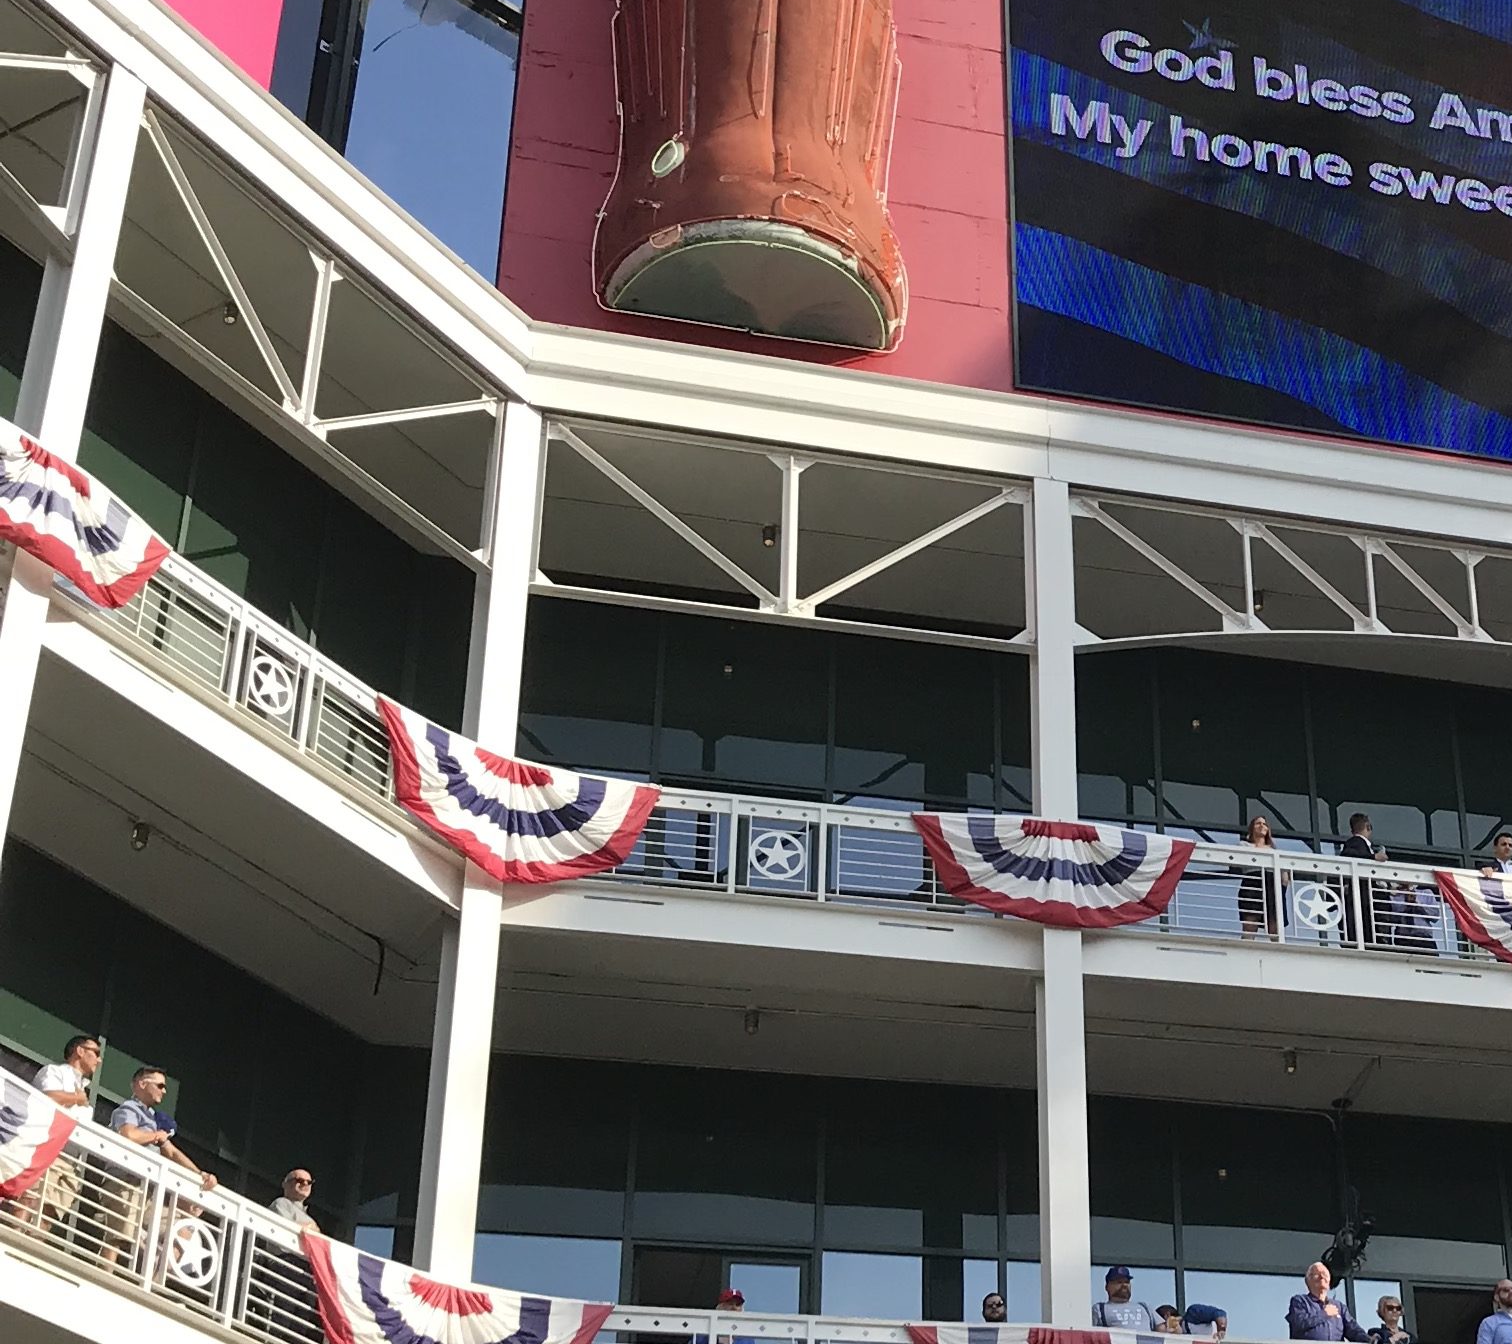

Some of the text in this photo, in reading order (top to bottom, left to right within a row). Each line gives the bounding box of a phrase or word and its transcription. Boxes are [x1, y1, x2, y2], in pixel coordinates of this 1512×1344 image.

[1100, 29, 1237, 92] God
[1252, 55, 1416, 124] bless
[1049, 92, 1155, 158] My
[1169, 114, 1352, 187] home
